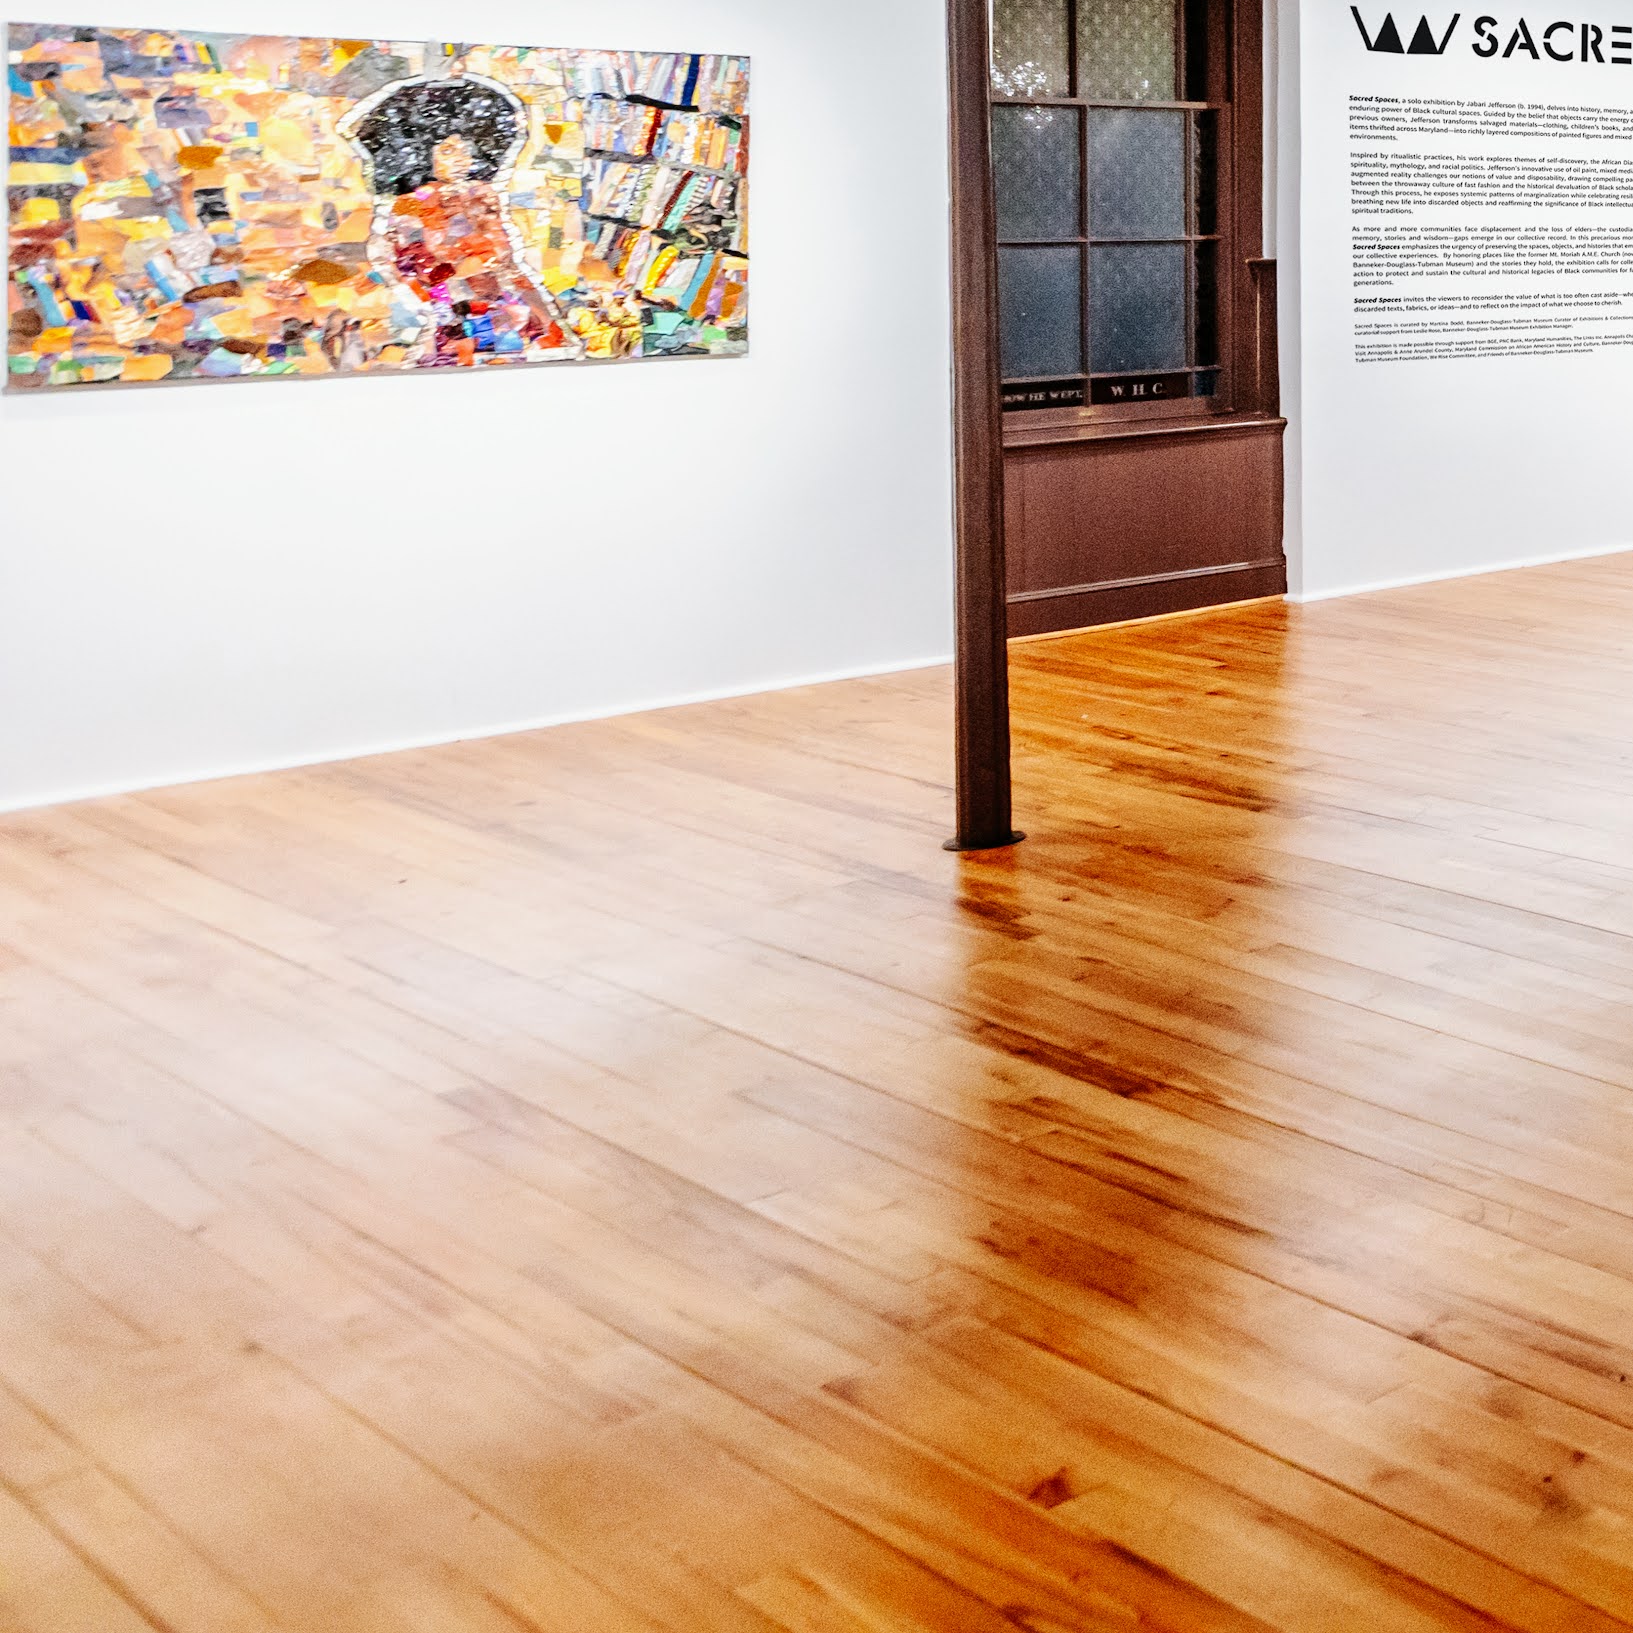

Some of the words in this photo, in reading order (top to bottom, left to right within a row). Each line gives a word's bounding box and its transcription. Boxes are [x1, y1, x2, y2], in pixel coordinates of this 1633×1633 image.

[1374, 96, 1401, 104] Spaces,
[1349, 104, 1380, 113] enduring
[1349, 114, 1379, 122] previous
[1480, 119, 1507, 128] salvaged
[1510, 130, 1551, 138] compositions
[1351, 170, 1390, 178] augmented
